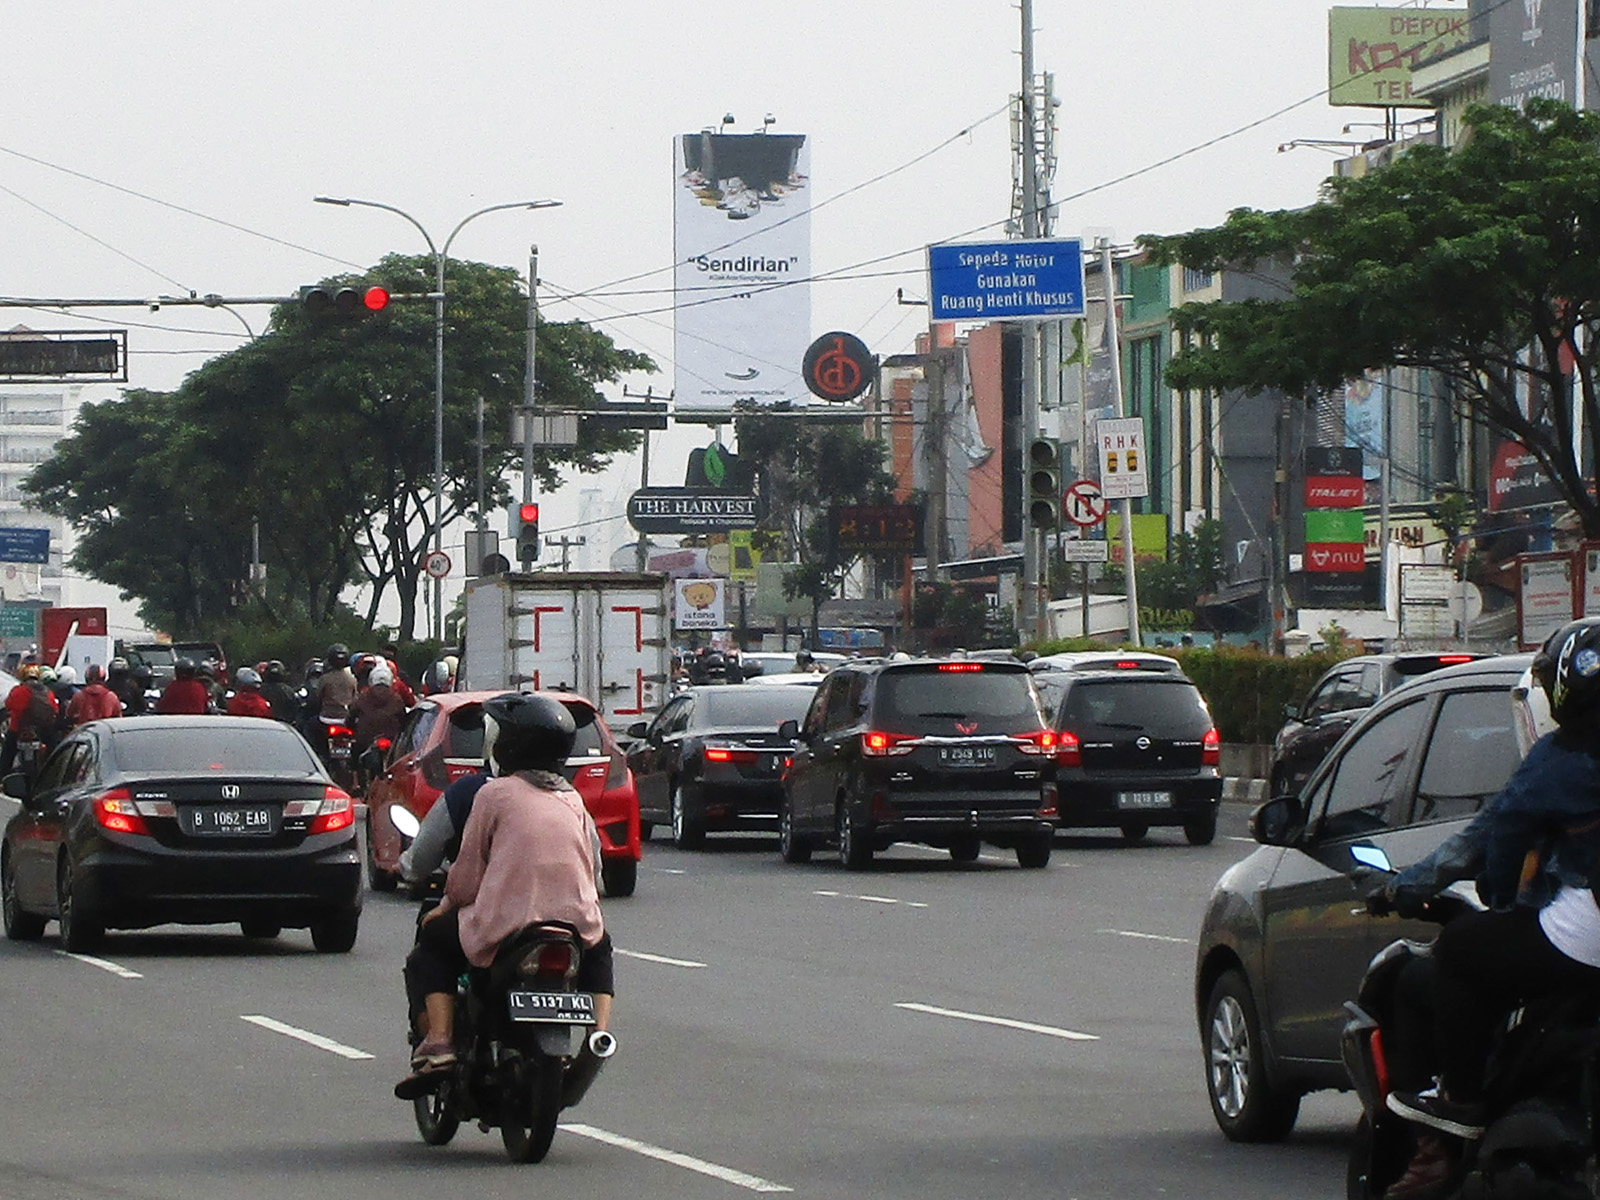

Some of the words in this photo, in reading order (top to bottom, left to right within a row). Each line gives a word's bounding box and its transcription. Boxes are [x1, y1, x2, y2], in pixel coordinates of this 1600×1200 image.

[1391, 17, 1465, 36] DEPOK
[959, 251, 1008, 269] Sepeda
[1015, 253, 1055, 268] Motor
[977, 272, 1036, 288] Gunakan
[941, 294, 983, 312] Ruang
[987, 290, 1023, 307] Henti
[1026, 290, 1074, 306] Khusus
[1309, 488, 1360, 498] ITALJET
[634, 500, 670, 513] THE
[675, 500, 756, 514] HARVEST
[194, 812, 203, 826] B
[213, 811, 240, 825] 1062
[246, 811, 268, 825] EAB
[515, 995, 525, 1007] L
[531, 995, 564, 1008] 5137
[571, 996, 590, 1010] KL
